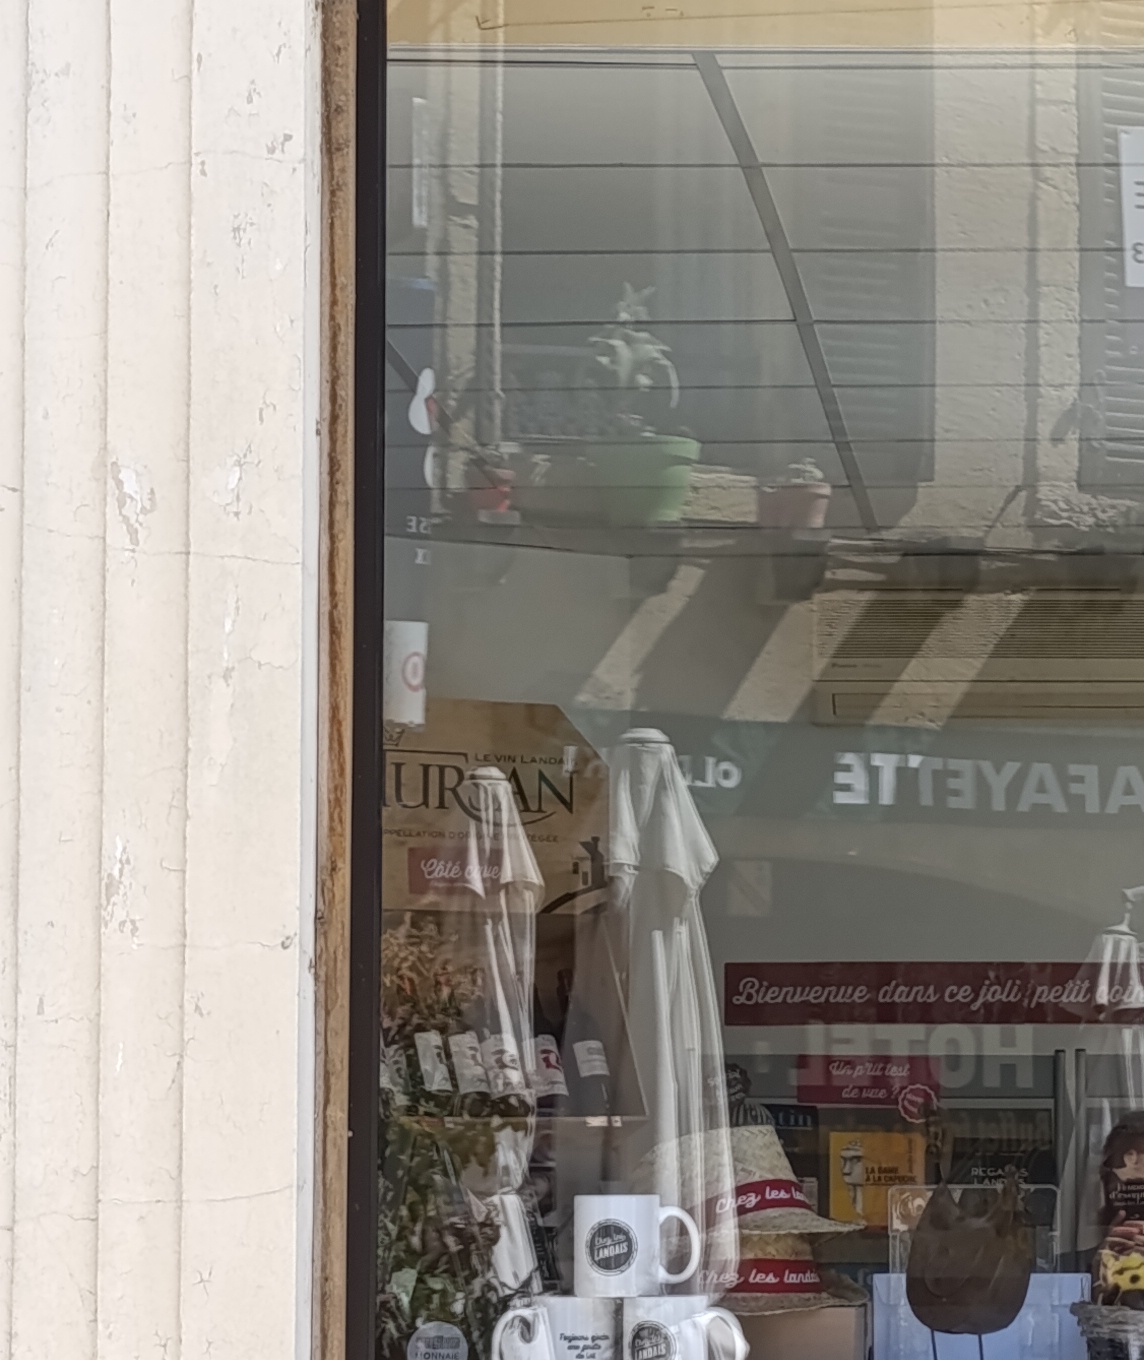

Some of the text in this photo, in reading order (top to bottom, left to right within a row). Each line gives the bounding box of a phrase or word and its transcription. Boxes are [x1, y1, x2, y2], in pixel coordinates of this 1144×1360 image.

[421, 859, 463, 879] Côté
[731, 975, 871, 1006] Bienvenue
[879, 979, 941, 1005] dans
[945, 984, 975, 1005] ce
[970, 978, 1023, 1011] joli
[1030, 977, 1090, 1010] petit
[765, 1185, 791, 1200] les
[594, 1241, 629, 1261] LANDAIS
[748, 1268, 780, 1284] les
